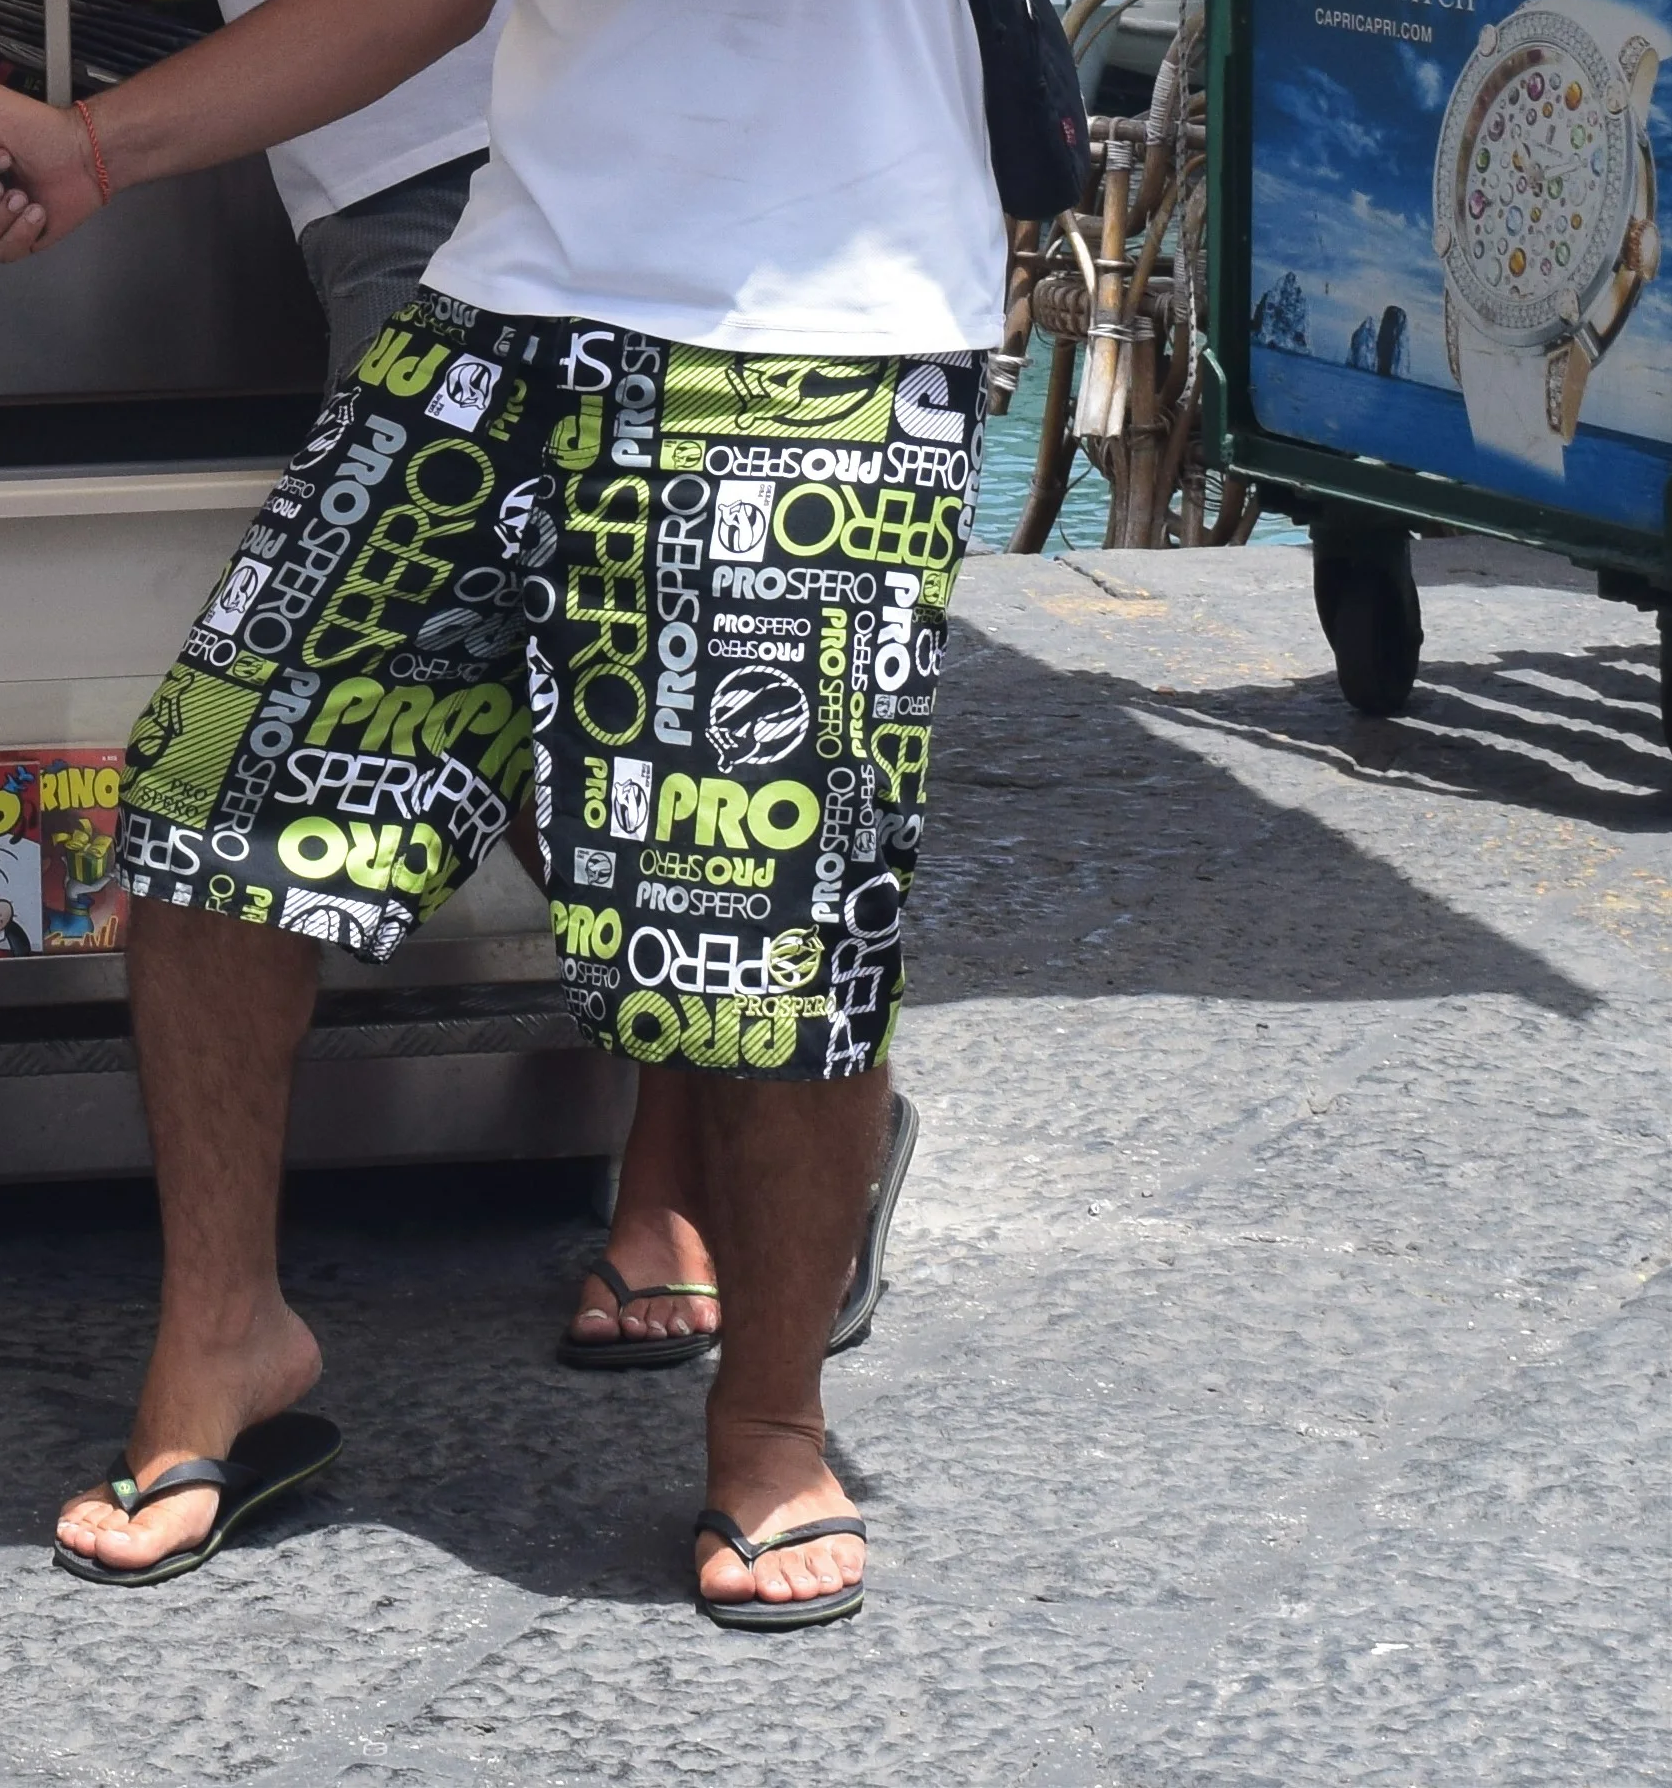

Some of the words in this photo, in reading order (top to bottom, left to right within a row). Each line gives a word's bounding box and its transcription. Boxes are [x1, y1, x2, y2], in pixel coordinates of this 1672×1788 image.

[1313, 6, 1433, 45] CAPRICAPRI.COM
[773, 481, 963, 570] SPERO
[711, 563, 877, 605] PROSPERO
[713, 612, 812, 637] PROSPERO
[874, 571, 920, 693] PRO
[583, 756, 608, 830] PRO
[654, 772, 821, 851] PRO
[635, 879, 772, 920] PROSPERO
